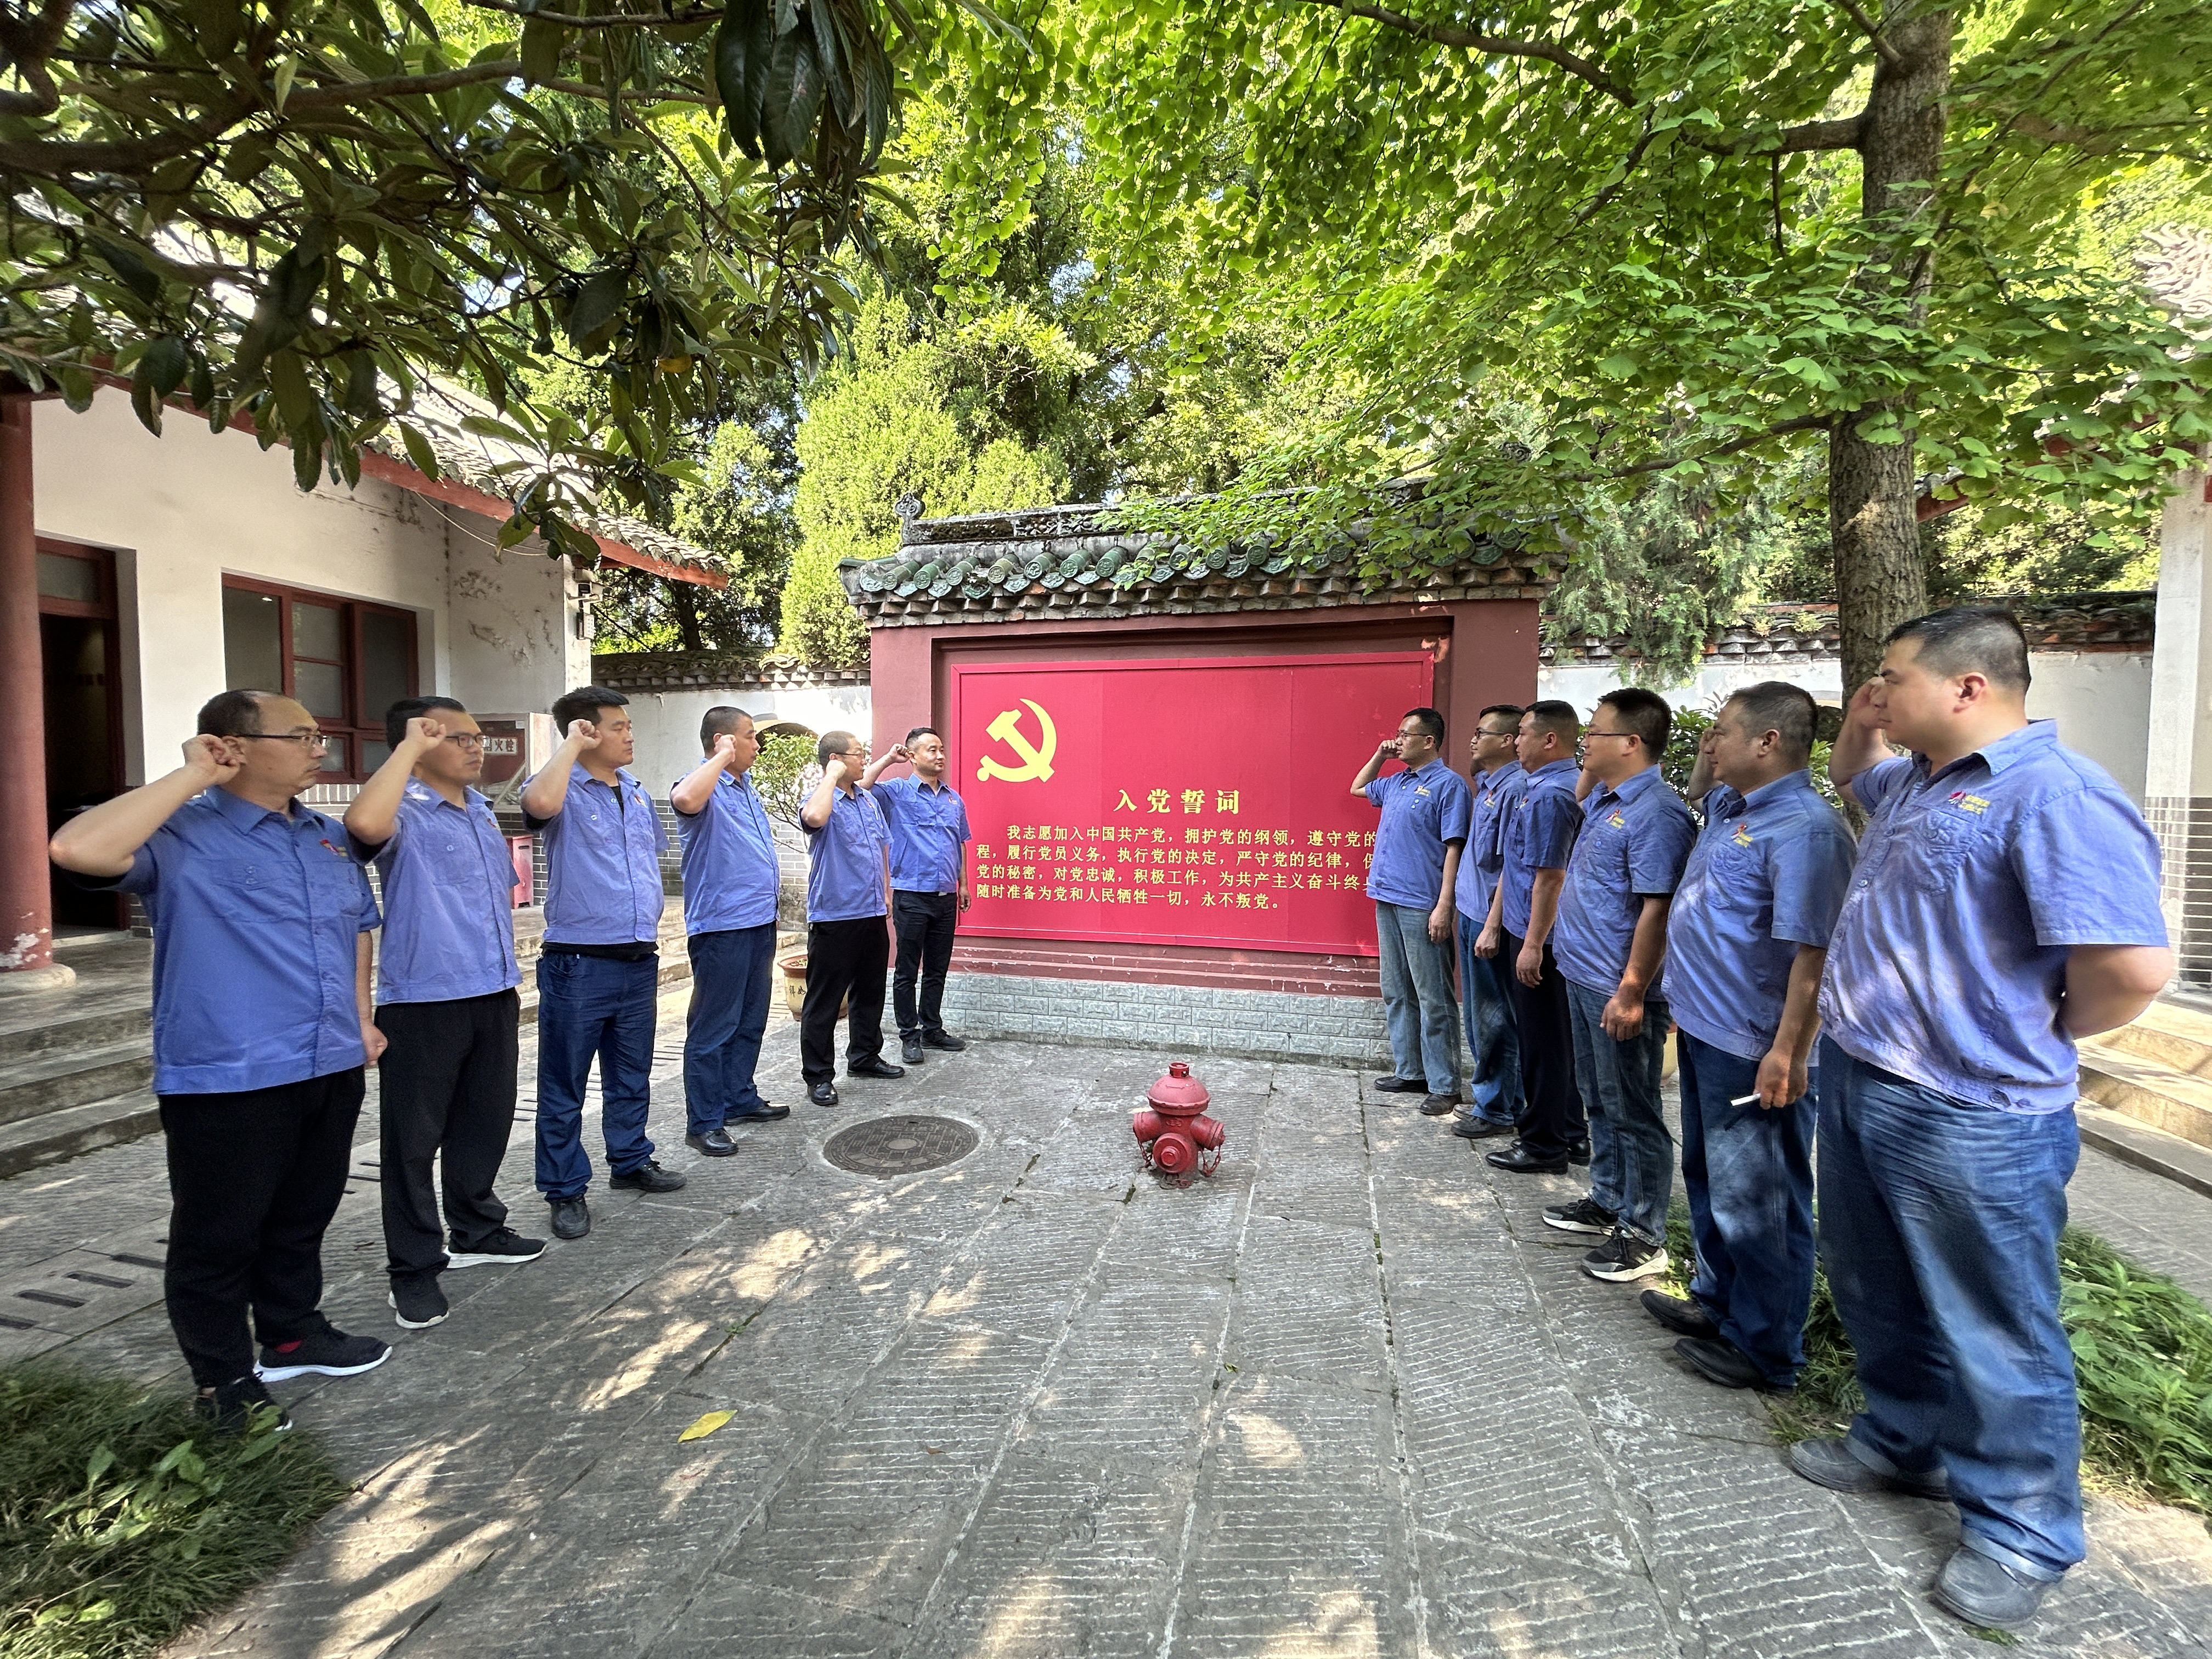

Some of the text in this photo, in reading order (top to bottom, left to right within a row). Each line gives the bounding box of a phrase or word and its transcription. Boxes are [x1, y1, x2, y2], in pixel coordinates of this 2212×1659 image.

[1113, 788, 1239, 815] 入党誓词
[976, 883, 1278, 909] 随时准备为党和人民牺牲一切，永不叛党。
